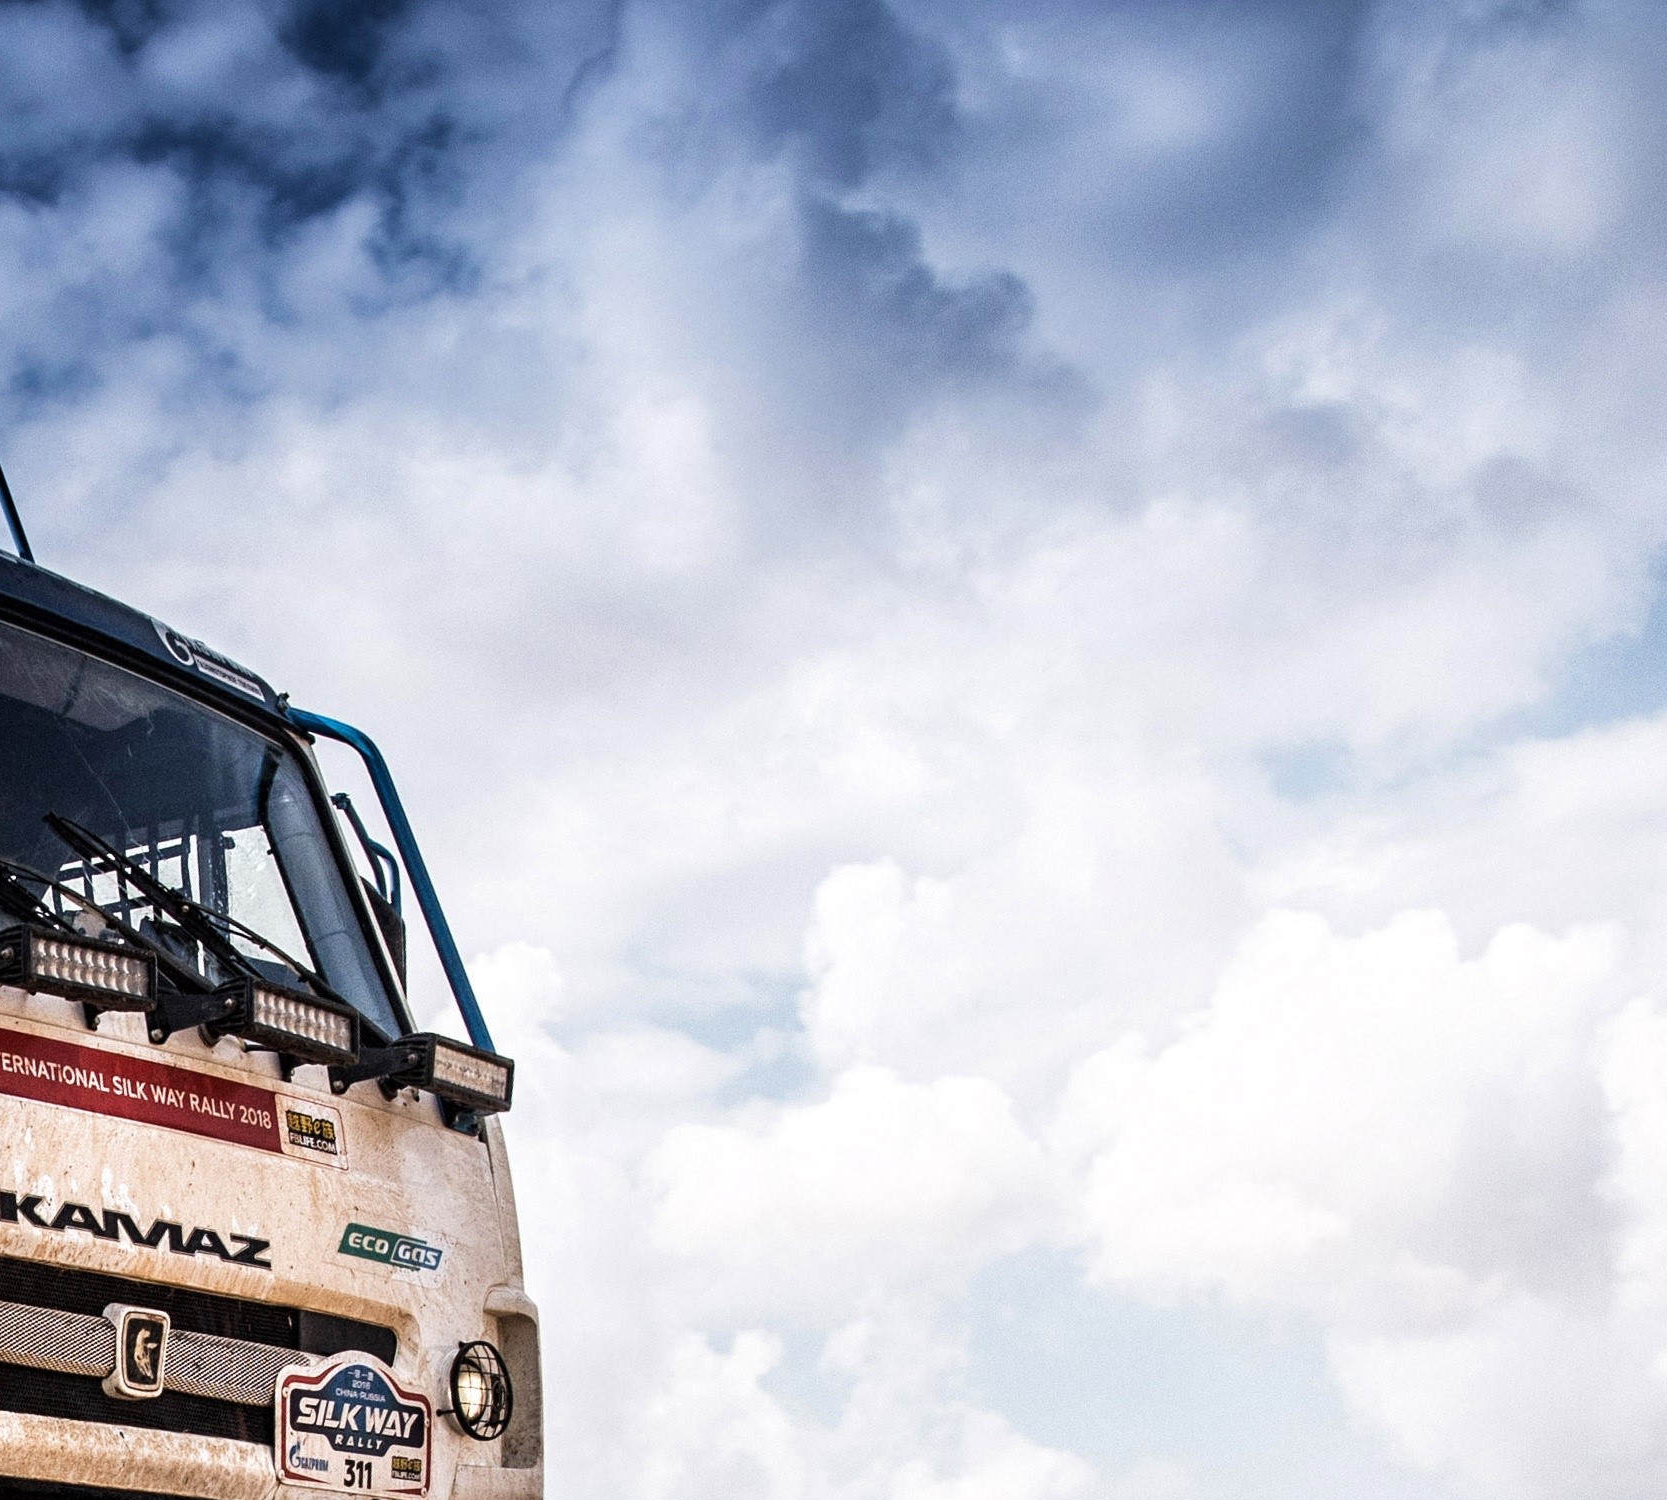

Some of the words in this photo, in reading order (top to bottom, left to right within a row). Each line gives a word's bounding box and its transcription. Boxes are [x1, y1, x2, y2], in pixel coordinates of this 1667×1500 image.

[112, 1076, 148, 1102] SILK
[149, 1084, 186, 1108] WAY
[189, 1092, 236, 1120] RALLY
[238, 1104, 272, 1130] 2018
[289, 1132, 337, 1154] FBLIFE.COM
[296, 1396, 362, 1431] SILK
[365, 1406, 419, 1439] WAY
[334, 1434, 383, 1450] RALLY
[343, 1459, 373, 1490] 311
